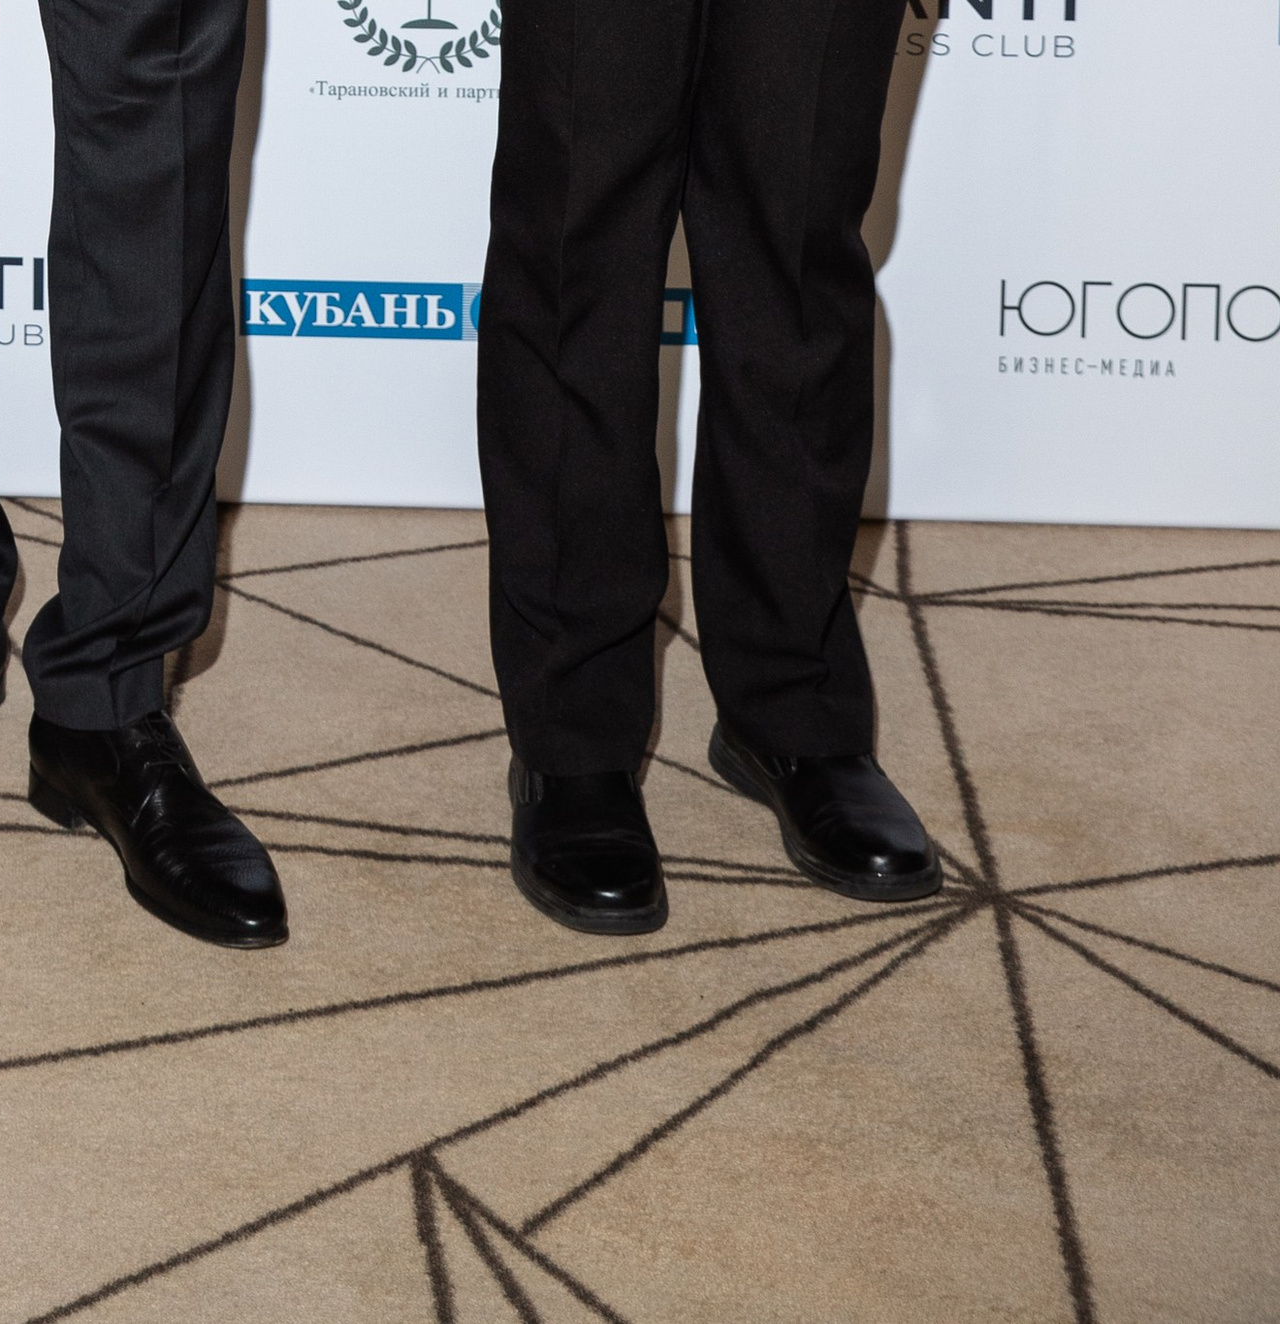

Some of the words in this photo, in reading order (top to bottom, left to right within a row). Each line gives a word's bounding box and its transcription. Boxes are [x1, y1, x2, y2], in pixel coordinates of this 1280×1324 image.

[971, 34, 1076, 58] CLUB
[309, 80, 431, 100] «Тарановский
[438, 86, 449, 98] и
[456, 86, 499, 103] парт
[246, 290, 456, 337] КУБАНЬ
[999, 279, 1280, 342] ЮГОПО
[998, 355, 1176, 378] БИЗНЕС-МЕДИА
